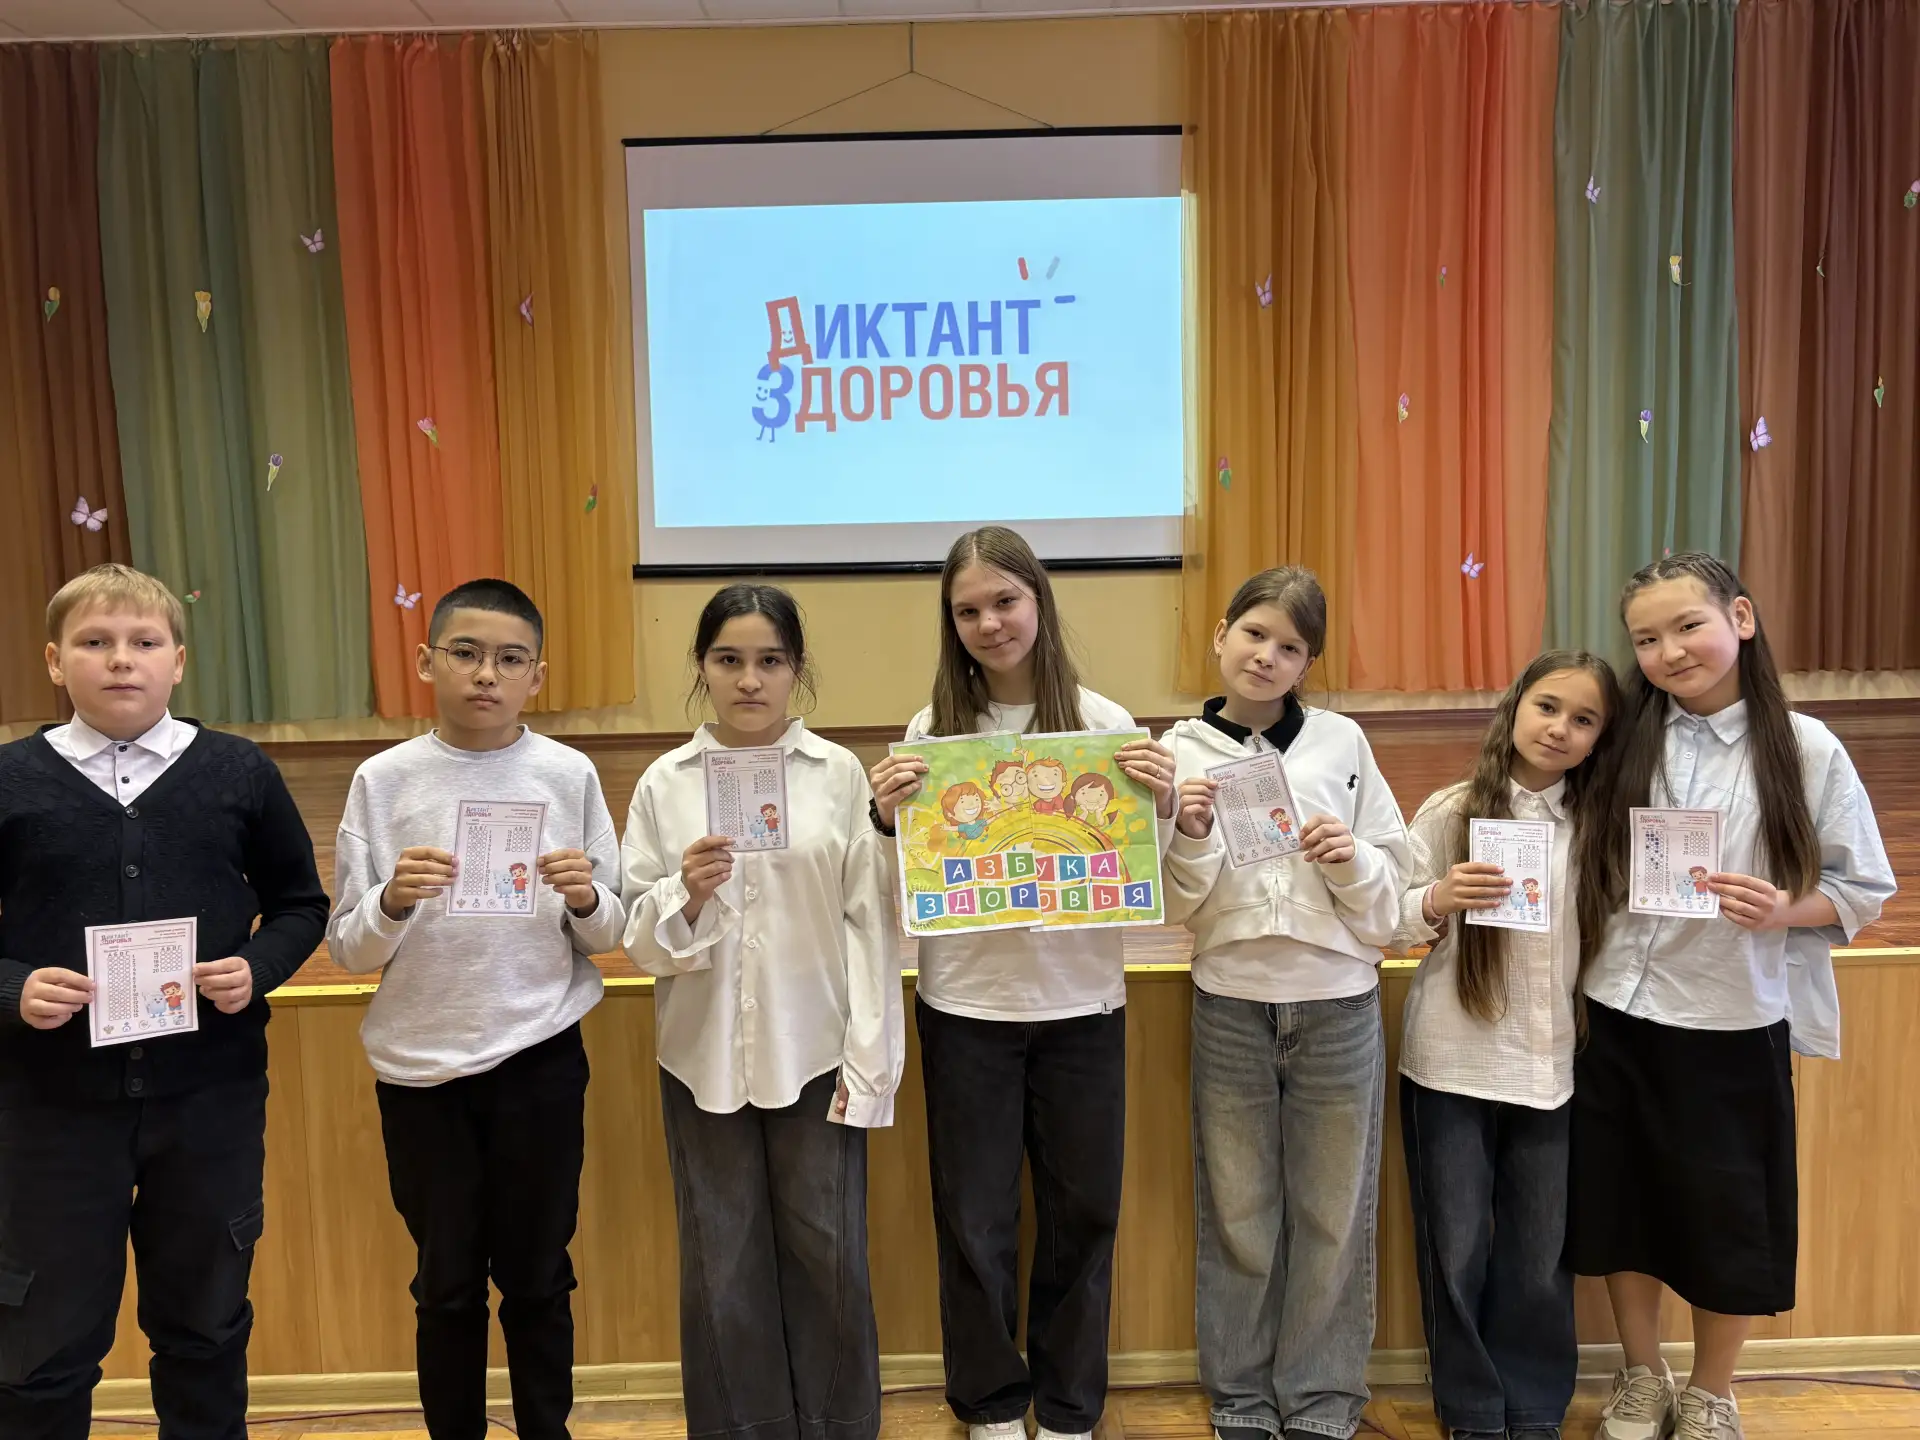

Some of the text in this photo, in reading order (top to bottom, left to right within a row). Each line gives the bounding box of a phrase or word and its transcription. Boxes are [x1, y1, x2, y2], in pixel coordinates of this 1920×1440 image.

[765, 295, 1041, 371] ДИКТАНТ
[751, 361, 1070, 434] ЗДОРОВЬЯ
[952, 855, 1112, 880] АЗБУКА
[924, 887, 1146, 914] ЗДОРОВЬЯ
[1103, 1002, 1111, 1012] L
